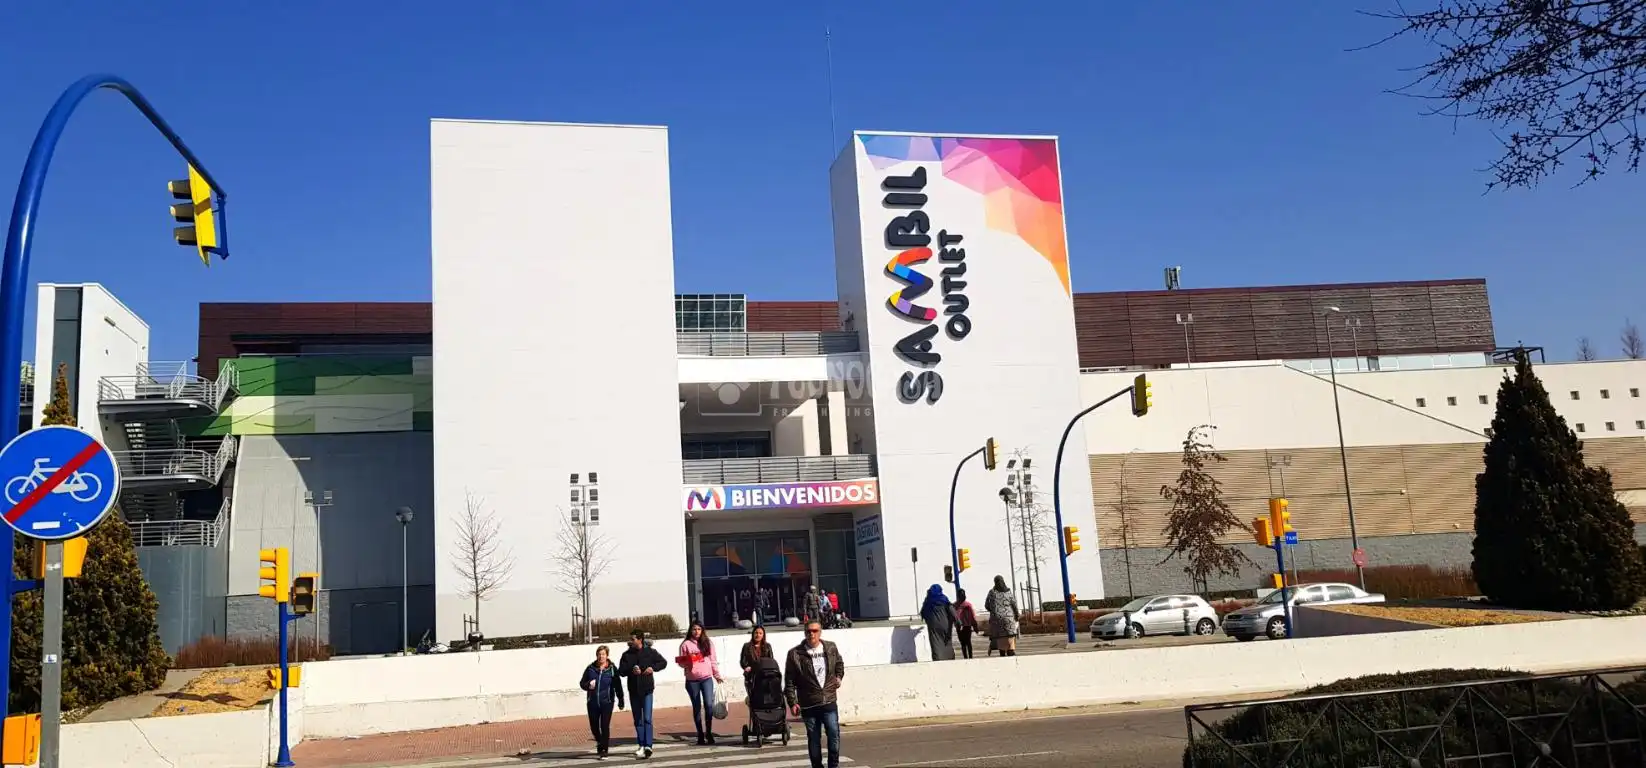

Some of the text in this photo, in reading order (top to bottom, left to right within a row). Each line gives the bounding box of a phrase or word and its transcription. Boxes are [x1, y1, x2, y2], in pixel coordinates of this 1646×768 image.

[882, 166, 943, 405] SAMBIL
[938, 229, 972, 341] OUTLET
[731, 484, 876, 507] BIENVENIDOS
